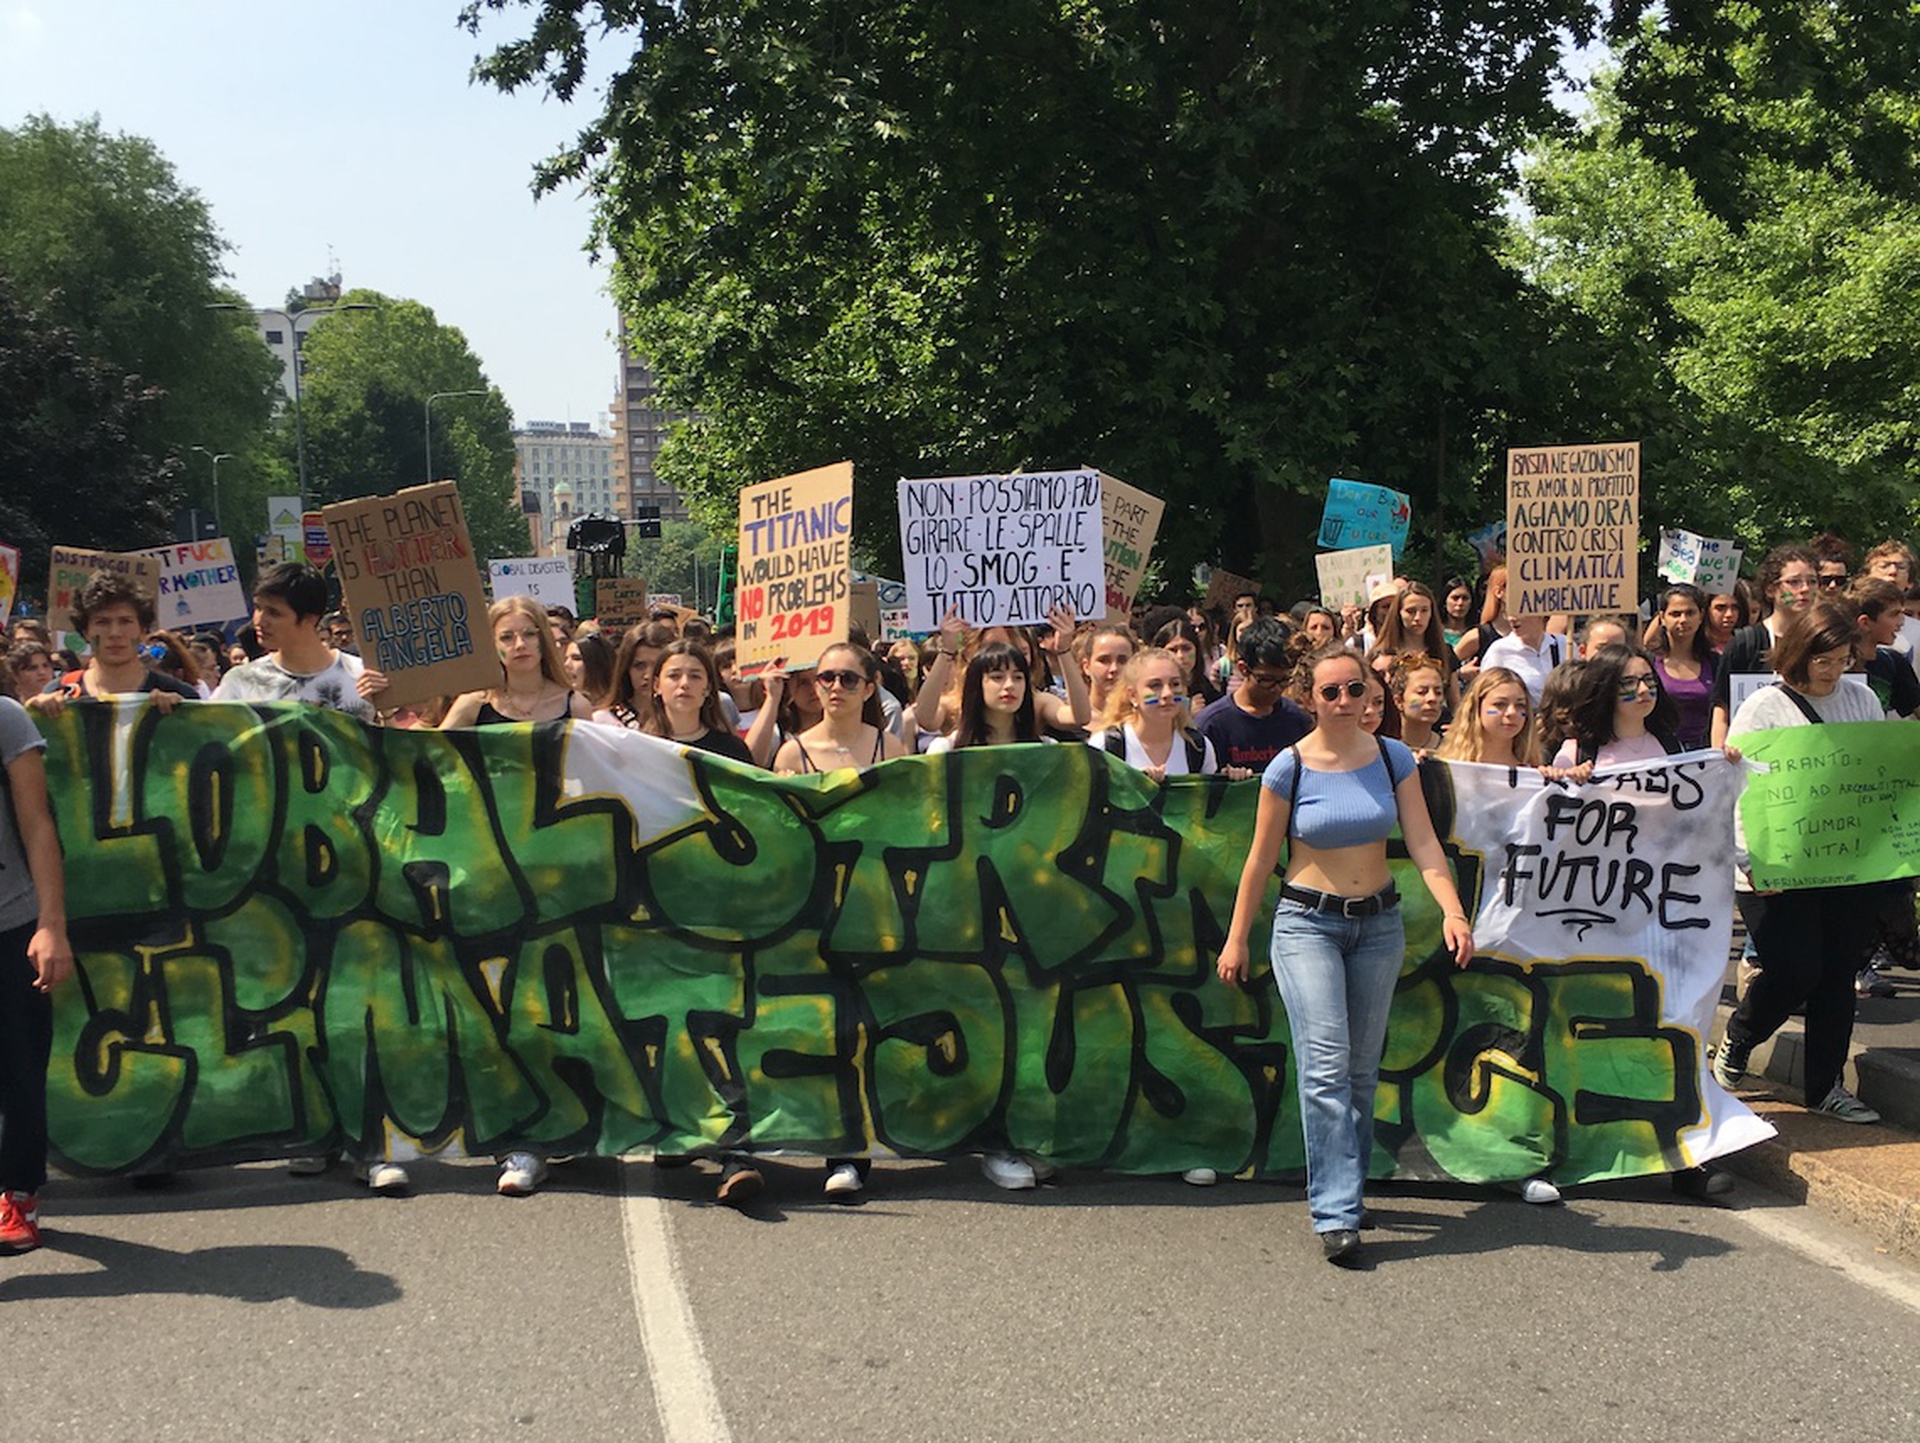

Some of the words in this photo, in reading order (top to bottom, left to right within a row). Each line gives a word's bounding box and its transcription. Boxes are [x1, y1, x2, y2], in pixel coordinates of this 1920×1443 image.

[1512, 453, 1549, 475] BASTA
[752, 487, 792, 518] THE
[907, 481, 955, 517] NON
[969, 477, 1067, 514] POSSIAMO
[1512, 481, 1531, 498] PER
[1536, 478, 1568, 497] AMOR
[1572, 478, 1582, 496] DI
[1588, 474, 1635, 498] PROFITTO
[329, 513, 376, 549] THE
[383, 493, 460, 538] PLANET
[744, 496, 850, 556] TITANIC
[1114, 496, 1149, 526] PART
[1514, 500, 1590, 528] AGIAMO
[1595, 498, 1633, 526] ORA
[907, 516, 973, 554] GIRARE
[986, 516, 1008, 550] LE
[1017, 511, 1088, 548] SPALLE
[1112, 520, 1139, 545] THE
[1513, 529, 1577, 554] CONTRO
[1581, 528, 1623, 552] CRISI
[177, 543, 225, 564] FUCK
[337, 551, 360, 581] IS
[365, 528, 467, 576] HOTTER
[528, 561, 568, 574] DISASTER
[741, 554, 795, 586] WOULD
[799, 541, 845, 573] HAVE
[926, 556, 948, 591] LO
[962, 551, 1038, 587] SMOG
[1520, 553, 1624, 581] CLIMATICA
[172, 565, 237, 592] MOTHER
[377, 566, 441, 602] THAN
[740, 587, 764, 621] NO
[768, 569, 846, 615] PROBLEMS
[361, 591, 468, 642] ALBERTO
[744, 621, 757, 640] IN
[771, 605, 834, 641] 2019
[927, 589, 995, 627] TUTTO
[1007, 583, 1095, 621] ATTORNO
[376, 623, 474, 673] ANGELA
[1768, 786, 1795, 801] NO
[1810, 784, 1831, 797] AD
[1544, 794, 1638, 854] FOR
[1793, 816, 1861, 835] TUMORI
[1803, 839, 1861, 859] VITA!
[1501, 843, 1711, 929] FUTURE
